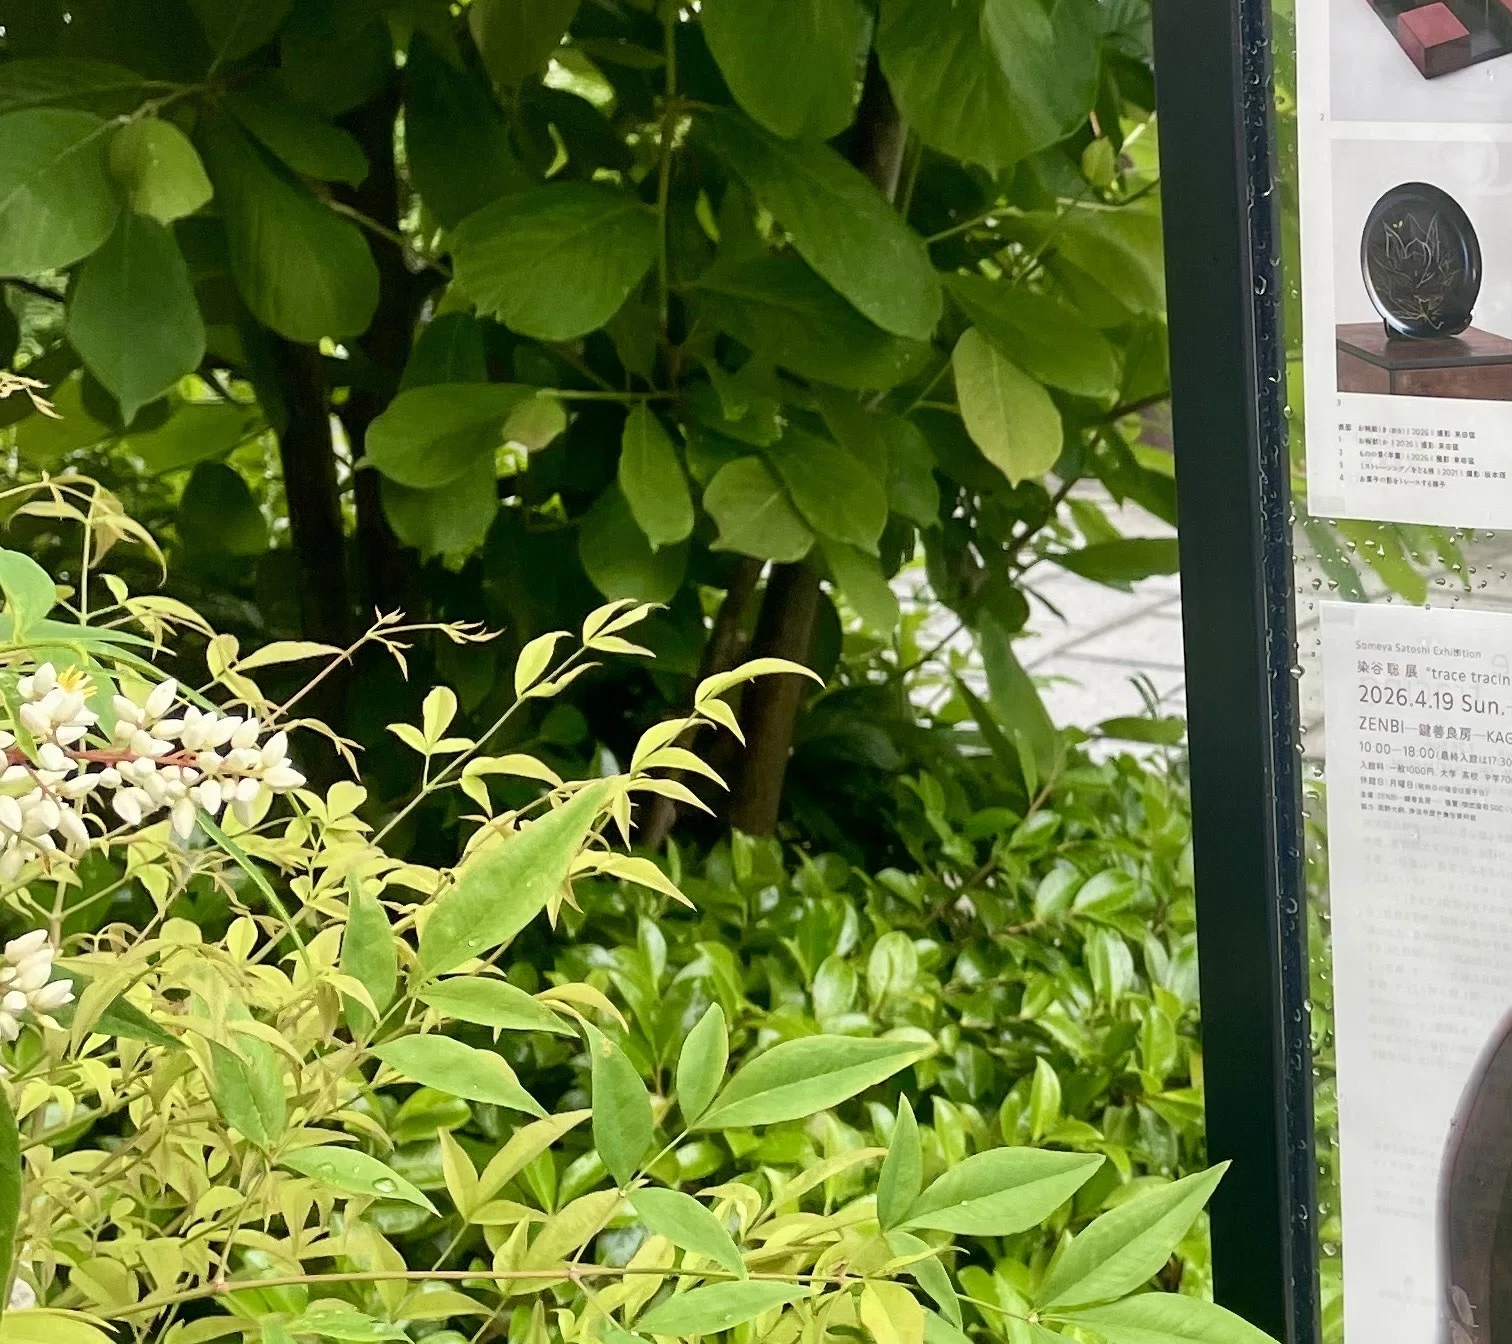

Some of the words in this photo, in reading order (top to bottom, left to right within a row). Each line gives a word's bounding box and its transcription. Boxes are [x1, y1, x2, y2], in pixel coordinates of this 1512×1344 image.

[1356, 640, 1393, 653] Someya
[1395, 642, 1431, 655] Satoshi
[1433, 645, 1482, 659] Exhibition
[1358, 684, 1454, 711] 2026.4.19
